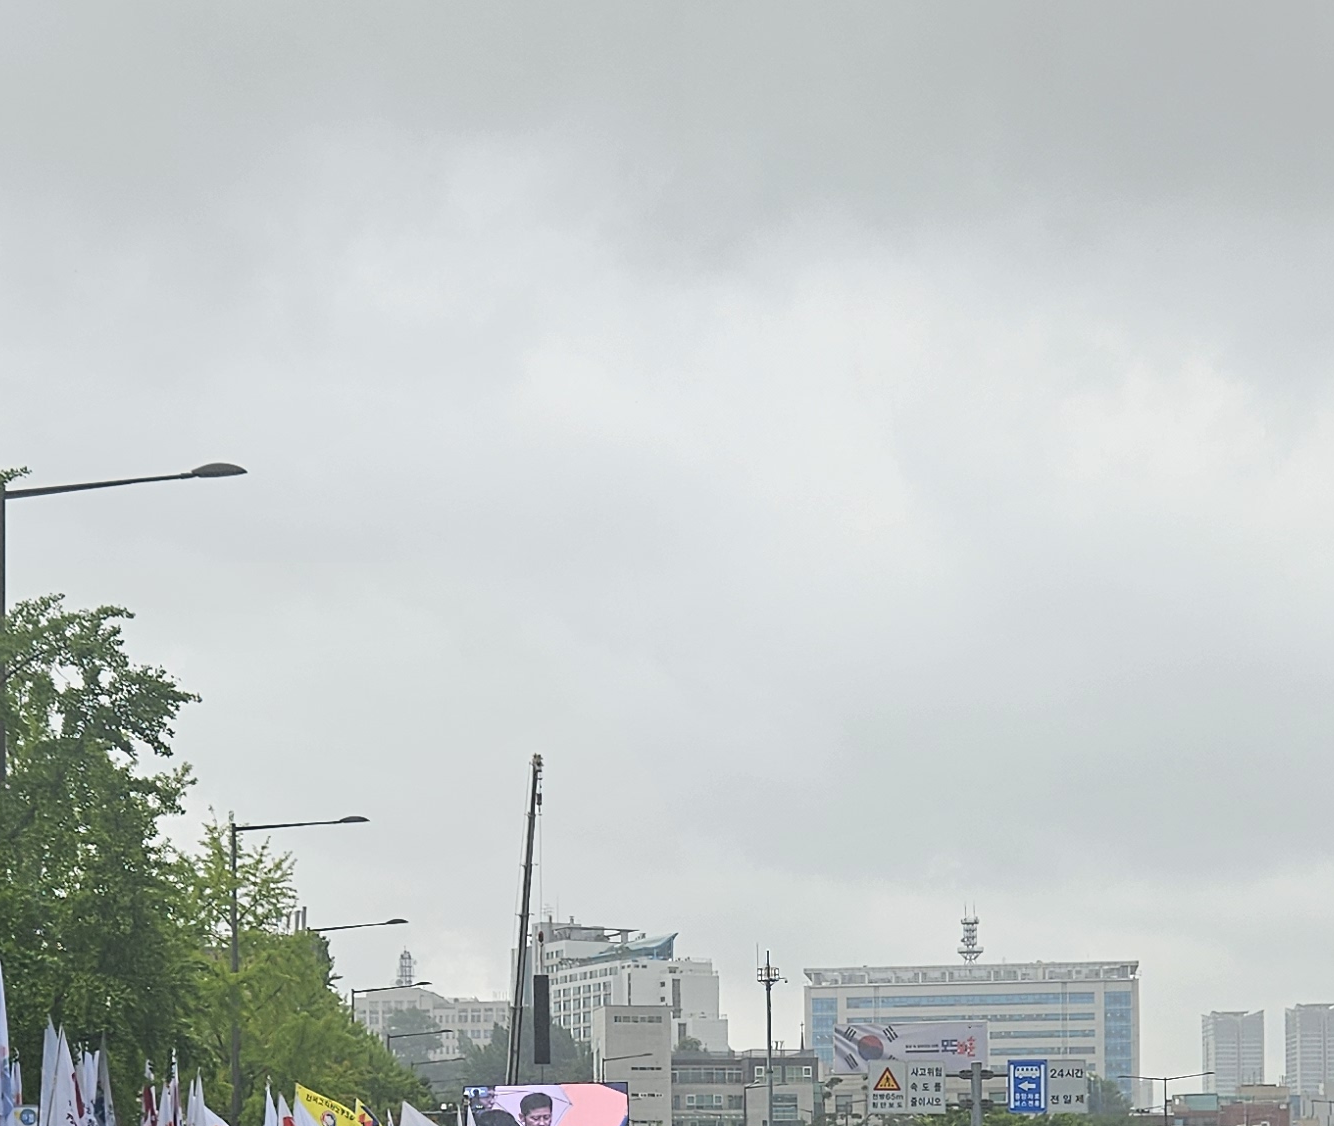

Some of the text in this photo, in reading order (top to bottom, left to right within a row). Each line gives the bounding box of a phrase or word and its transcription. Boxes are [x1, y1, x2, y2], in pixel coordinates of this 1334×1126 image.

[911, 1067, 942, 1077] 사고위험
[1050, 1068, 1083, 1079] 24시간
[872, 1093, 904, 1101] 전방65m
[1050, 1094, 1085, 1105] 전일제
[910, 1098, 942, 1107] 줄이시오
